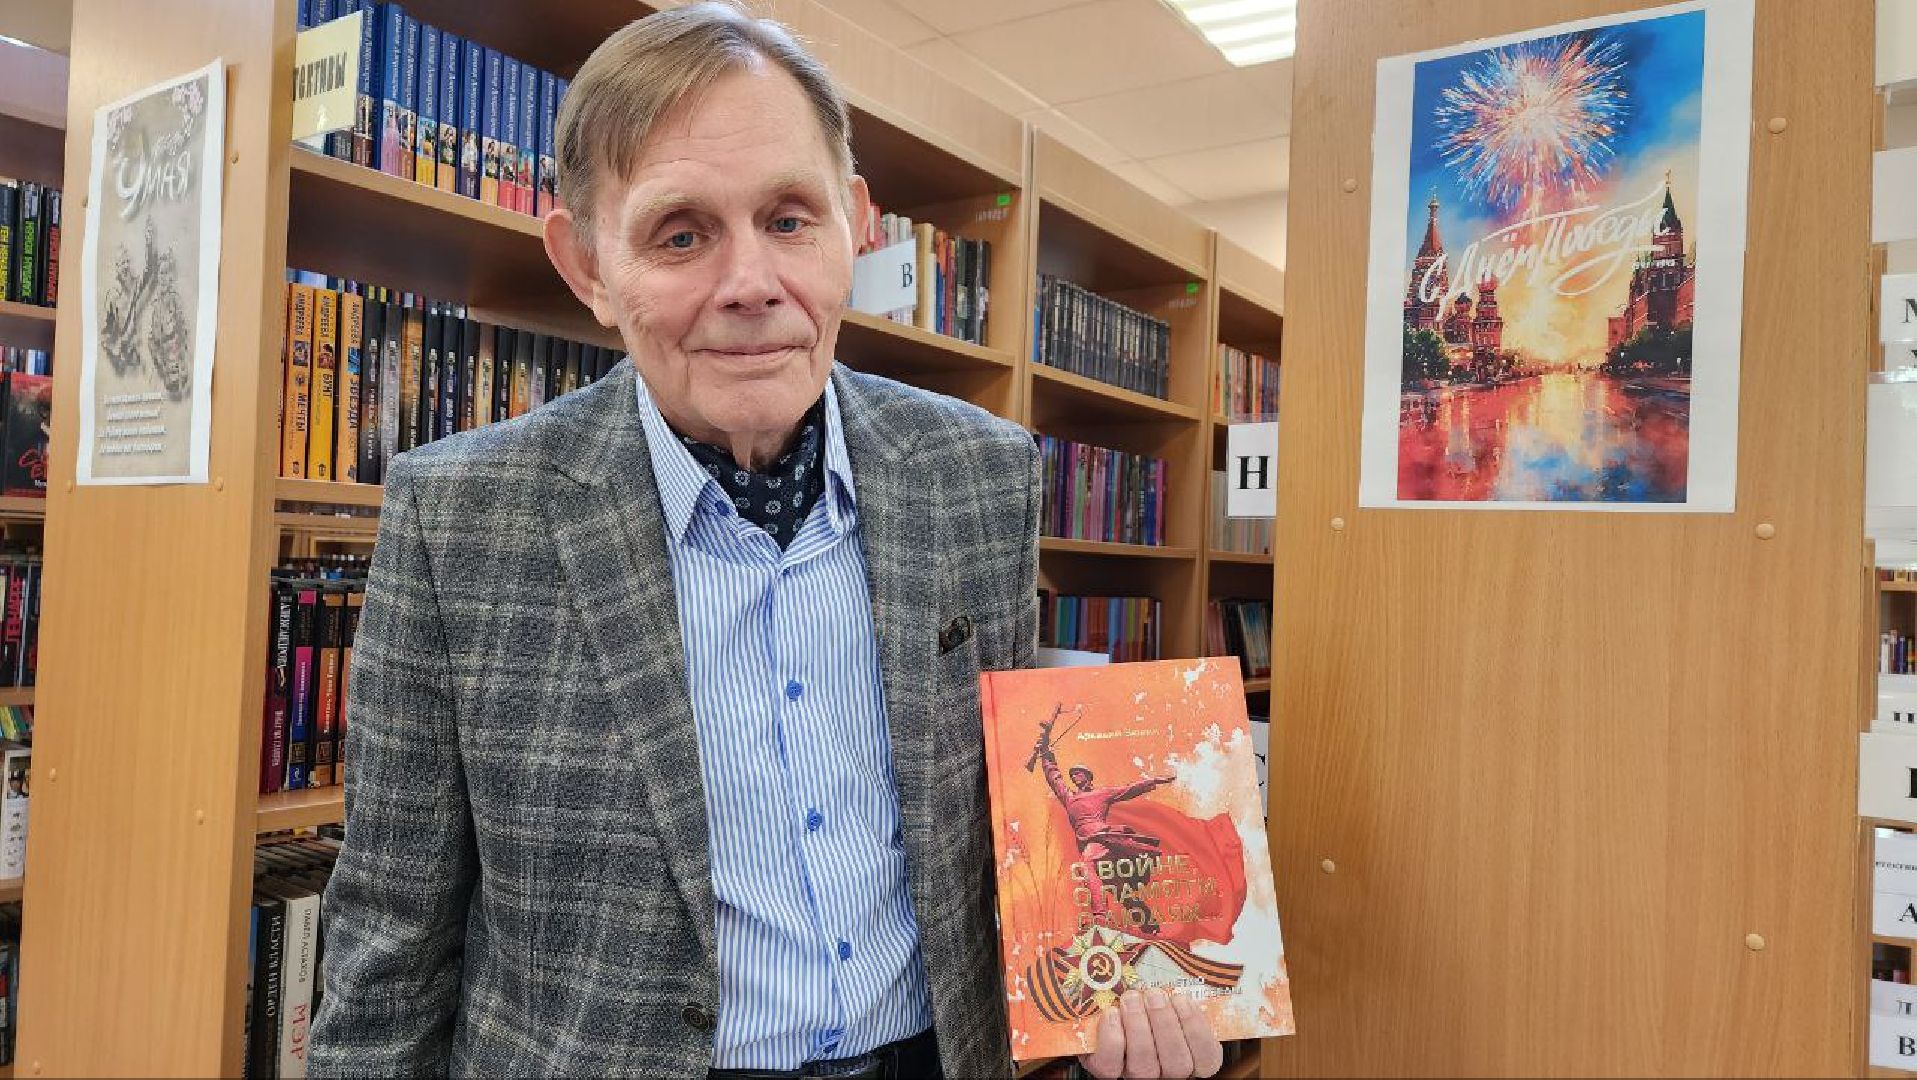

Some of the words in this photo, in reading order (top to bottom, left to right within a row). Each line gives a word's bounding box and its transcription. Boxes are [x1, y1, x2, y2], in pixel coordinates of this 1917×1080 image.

[902, 263, 912, 287] В
[1235, 456, 1270, 489] Н
[1070, 862, 1089, 881] О
[1099, 853, 1198, 880] ВОЙНЕ,
[1074, 887, 1092, 907] О
[1897, 1035, 1915, 1057] В
